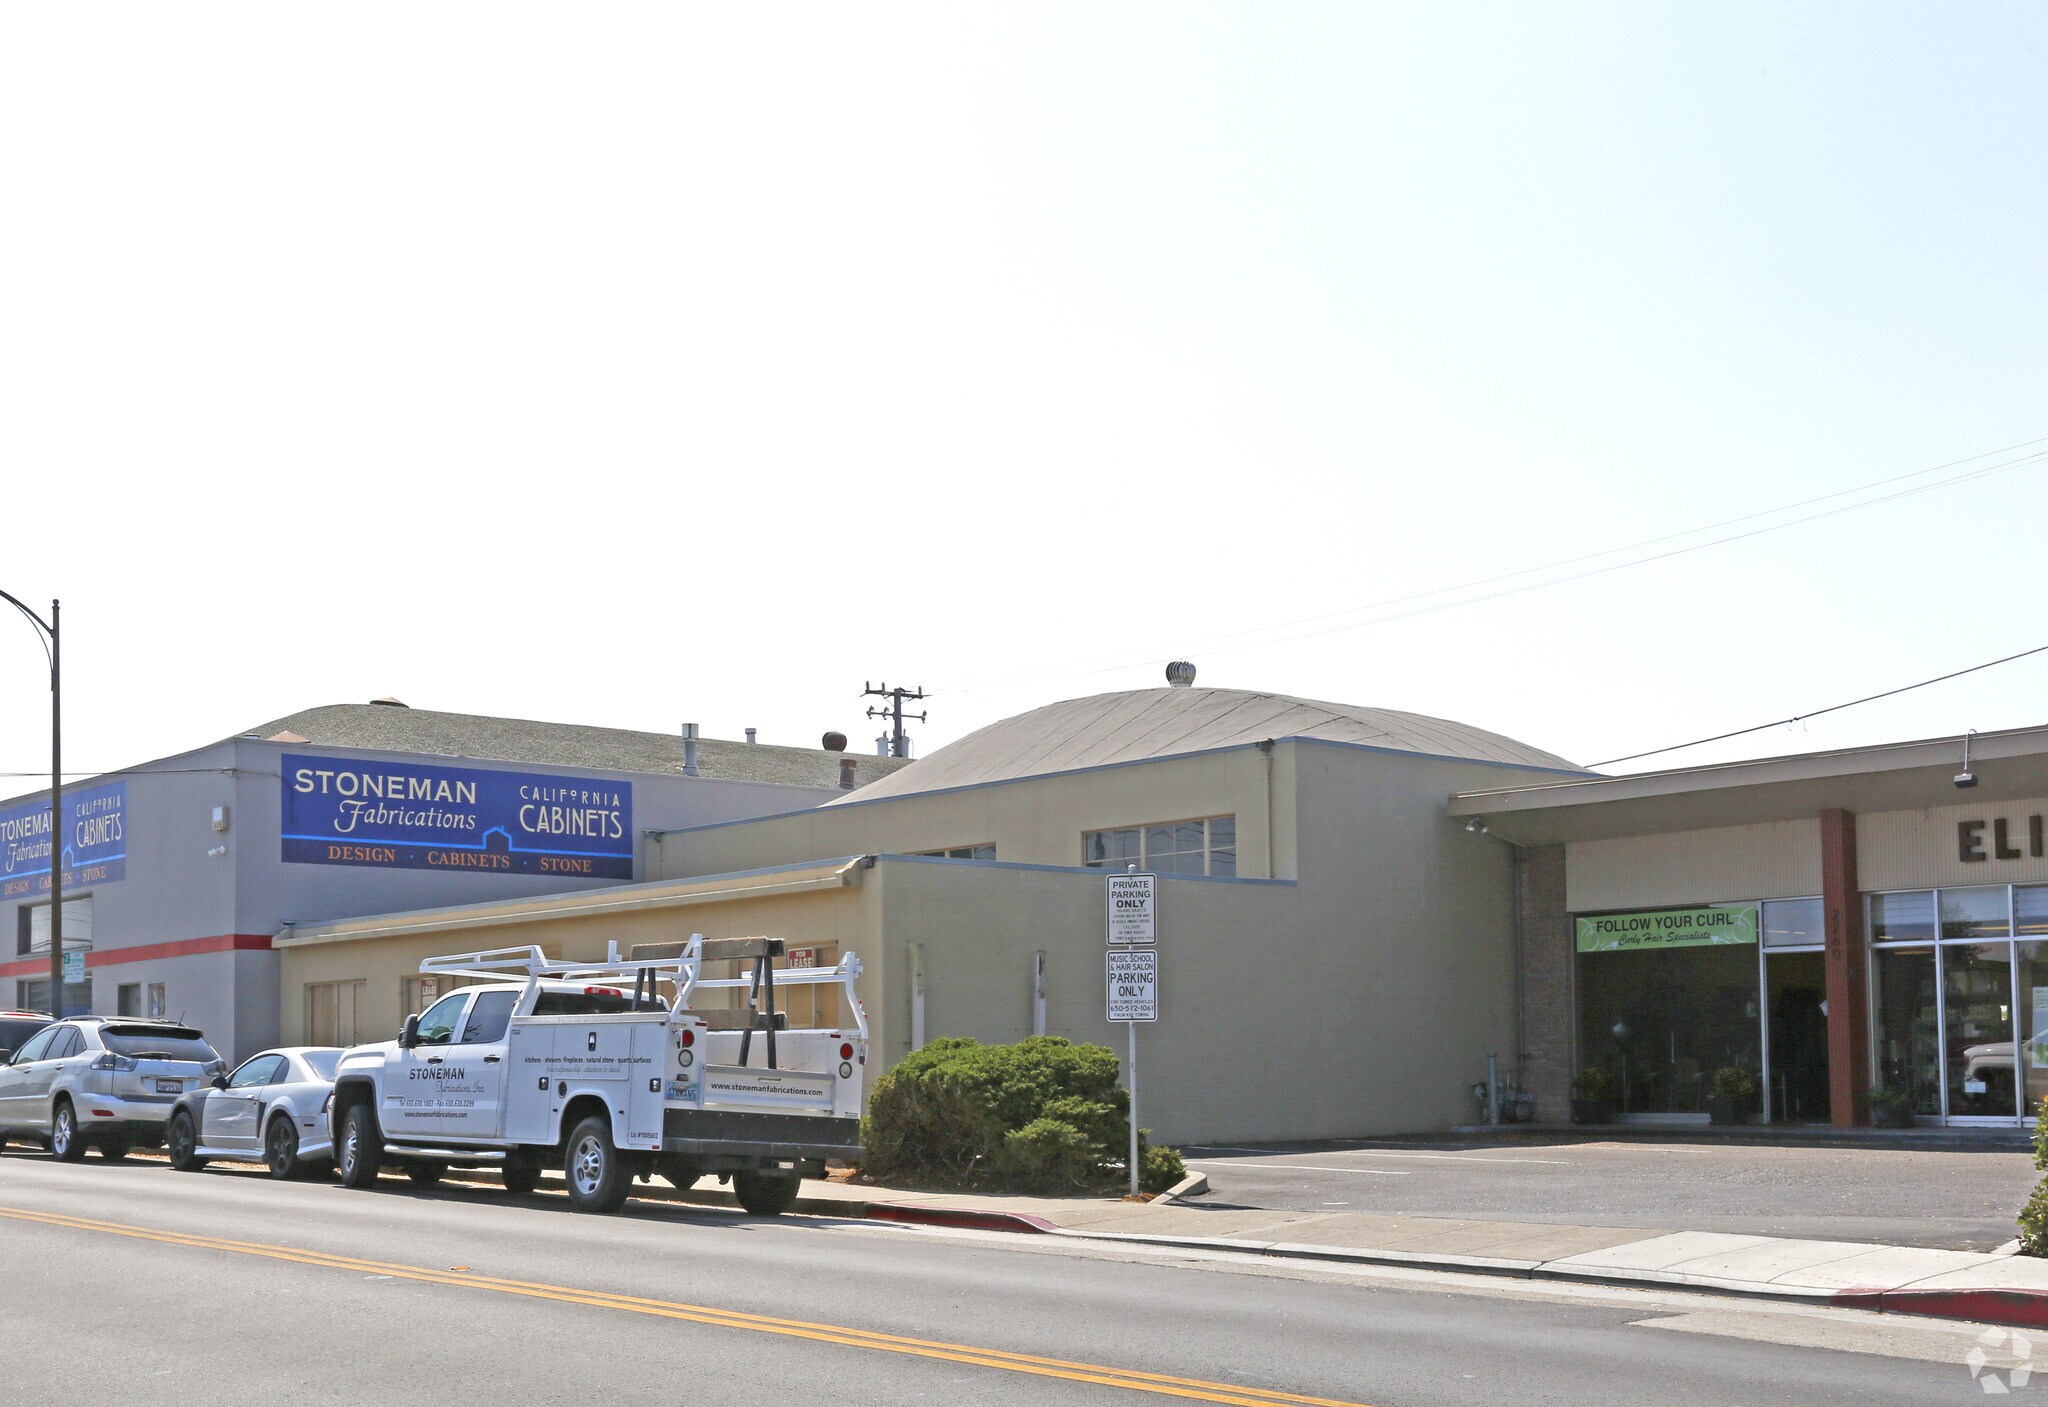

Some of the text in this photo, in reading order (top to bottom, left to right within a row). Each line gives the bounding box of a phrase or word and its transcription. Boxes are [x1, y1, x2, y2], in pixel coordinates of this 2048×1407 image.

[294, 768, 476, 804] STONEMAN
[519, 785, 620, 807] CALIFORNIA
[76, 795, 121, 817] CALIFORNIA
[333, 799, 476, 833] Fabrications
[76, 813, 122, 848] CABINETS
[519, 804, 623, 839] CABINETS
[1957, 814, 2043, 863] ELI
[6, 839, 53, 873] Fabrication
[328, 846, 592, 873] DESIGN CABINETS STONE
[5, 880, 29, 895] DESIGN
[82, 866, 106, 882] STONE
[1113, 881, 1149, 889] PRIVATE
[1116, 900, 1146, 908] ONLY
[1596, 913, 1734, 933] FOLLOW YOUR CURL
[1618, 930, 1711, 946] Curly Hair Specialists
[789, 957, 812, 969] LEASE
[795, 950, 807, 958] FOR
[1130, 954, 1153, 962] SCHOOL
[1110, 973, 1153, 983] PARKING
[1119, 985, 1145, 996] ONLY
[409, 1067, 465, 1080] STONEMAN
[711, 1082, 823, 1097] www.stonemanfabrications.com
